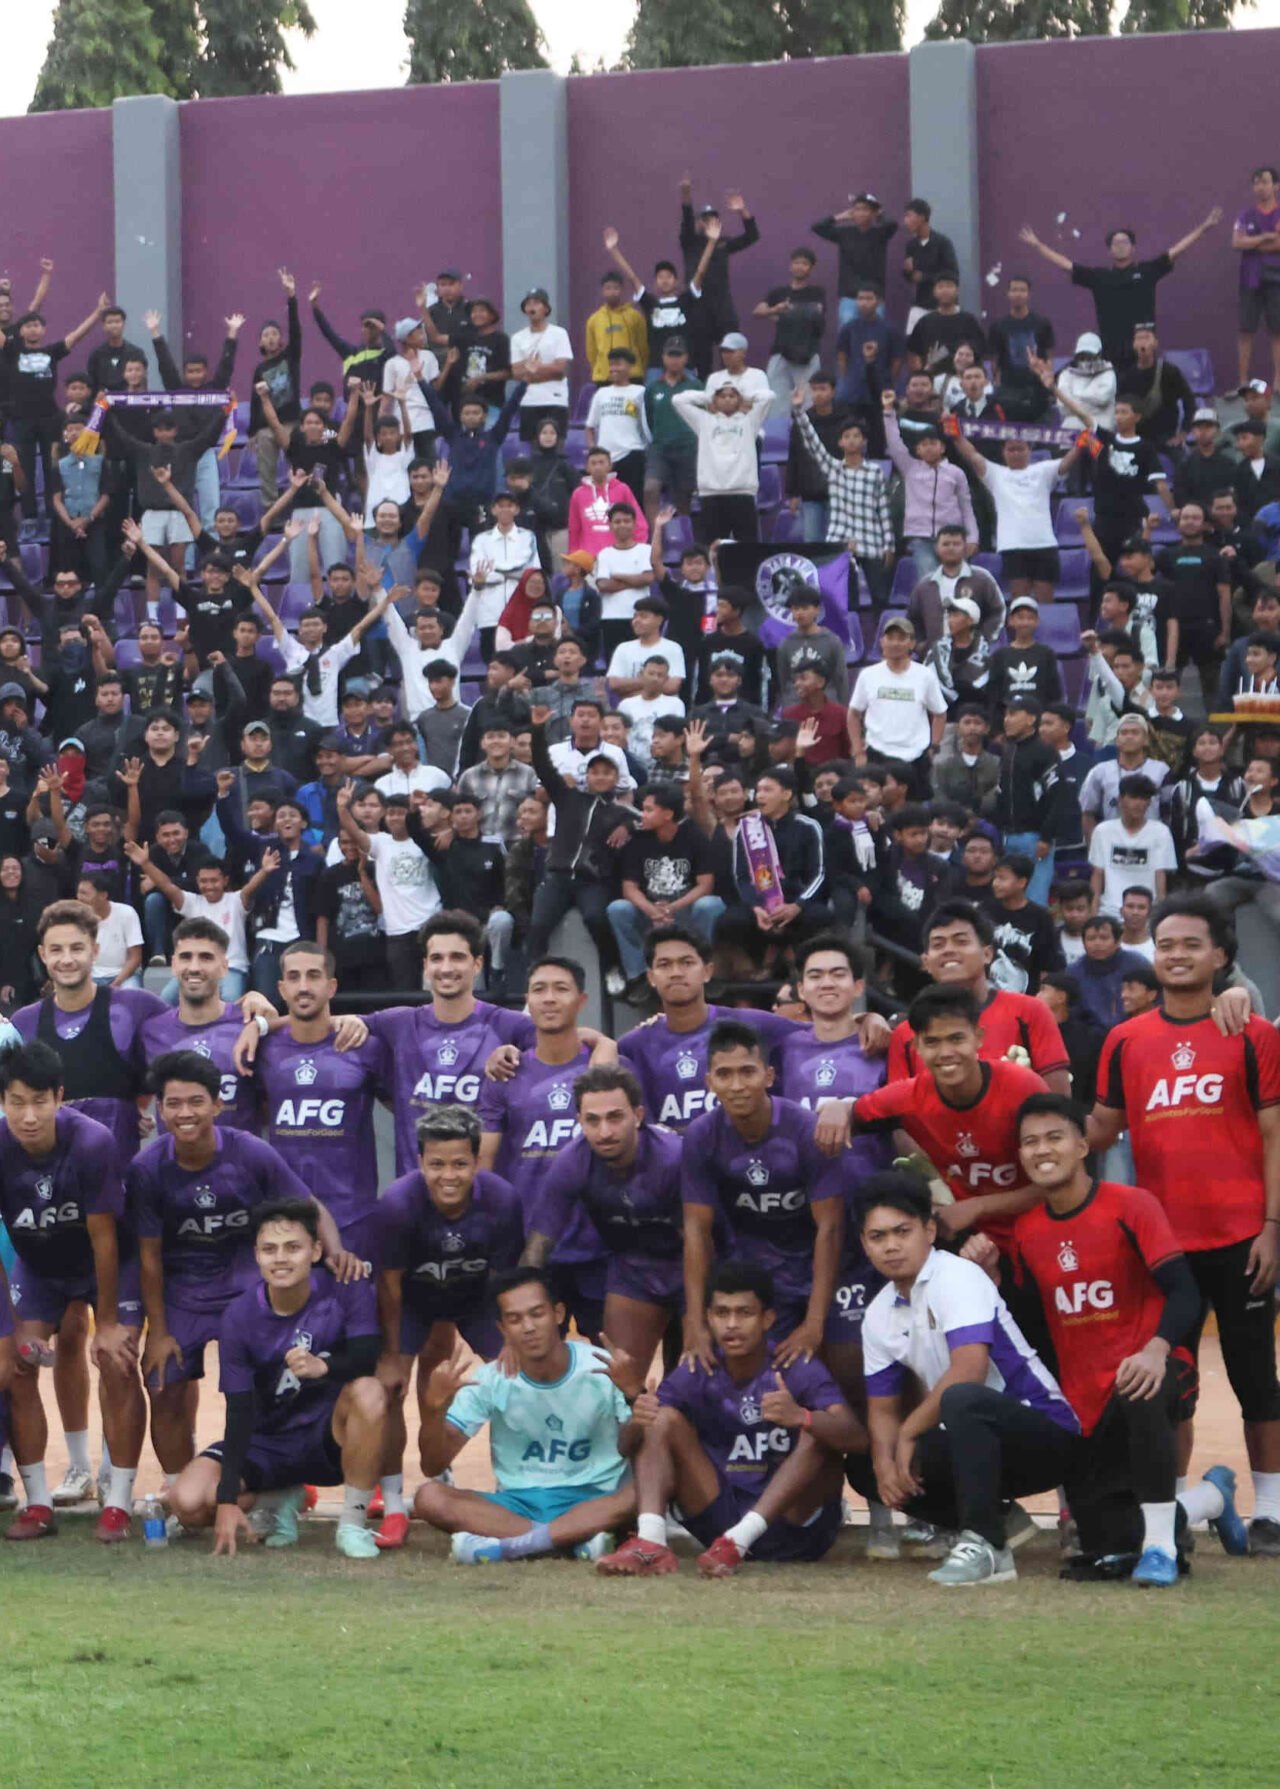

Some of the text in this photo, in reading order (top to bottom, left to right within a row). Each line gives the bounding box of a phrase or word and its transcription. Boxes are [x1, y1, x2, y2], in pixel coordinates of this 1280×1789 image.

[413, 1072, 480, 1102] AFG
[1145, 1073, 1224, 1112] AFG
[275, 1099, 345, 1126] AFG
[735, 1190, 805, 1213] AFG
[12, 1202, 79, 1230] AFG
[176, 1209, 250, 1235] AFG
[415, 1258, 488, 1281] AFG
[1055, 1280, 1114, 1314] AFG
[521, 1439, 592, 1463] AFG
[727, 1427, 791, 1461] AFG
